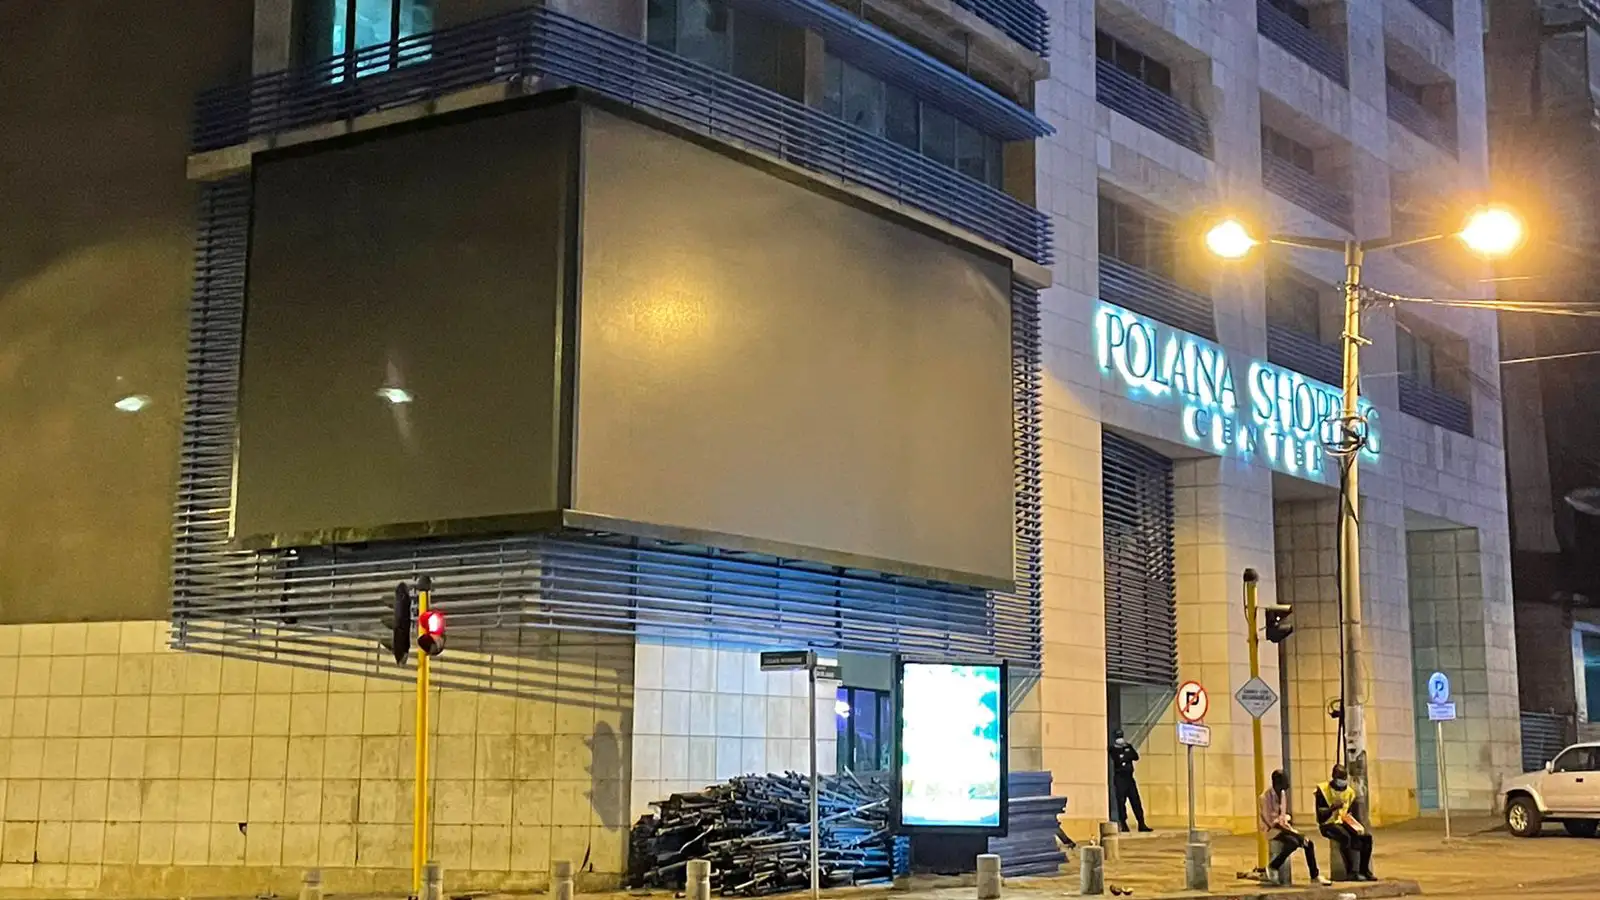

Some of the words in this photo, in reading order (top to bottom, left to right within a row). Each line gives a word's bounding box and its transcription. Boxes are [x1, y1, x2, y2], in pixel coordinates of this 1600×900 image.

[1103, 311, 1238, 408] POLANA
[1256, 368, 1380, 455] SHOPPG
[1193, 408, 1323, 473] CENTER
[1186, 692, 1200, 713] P
